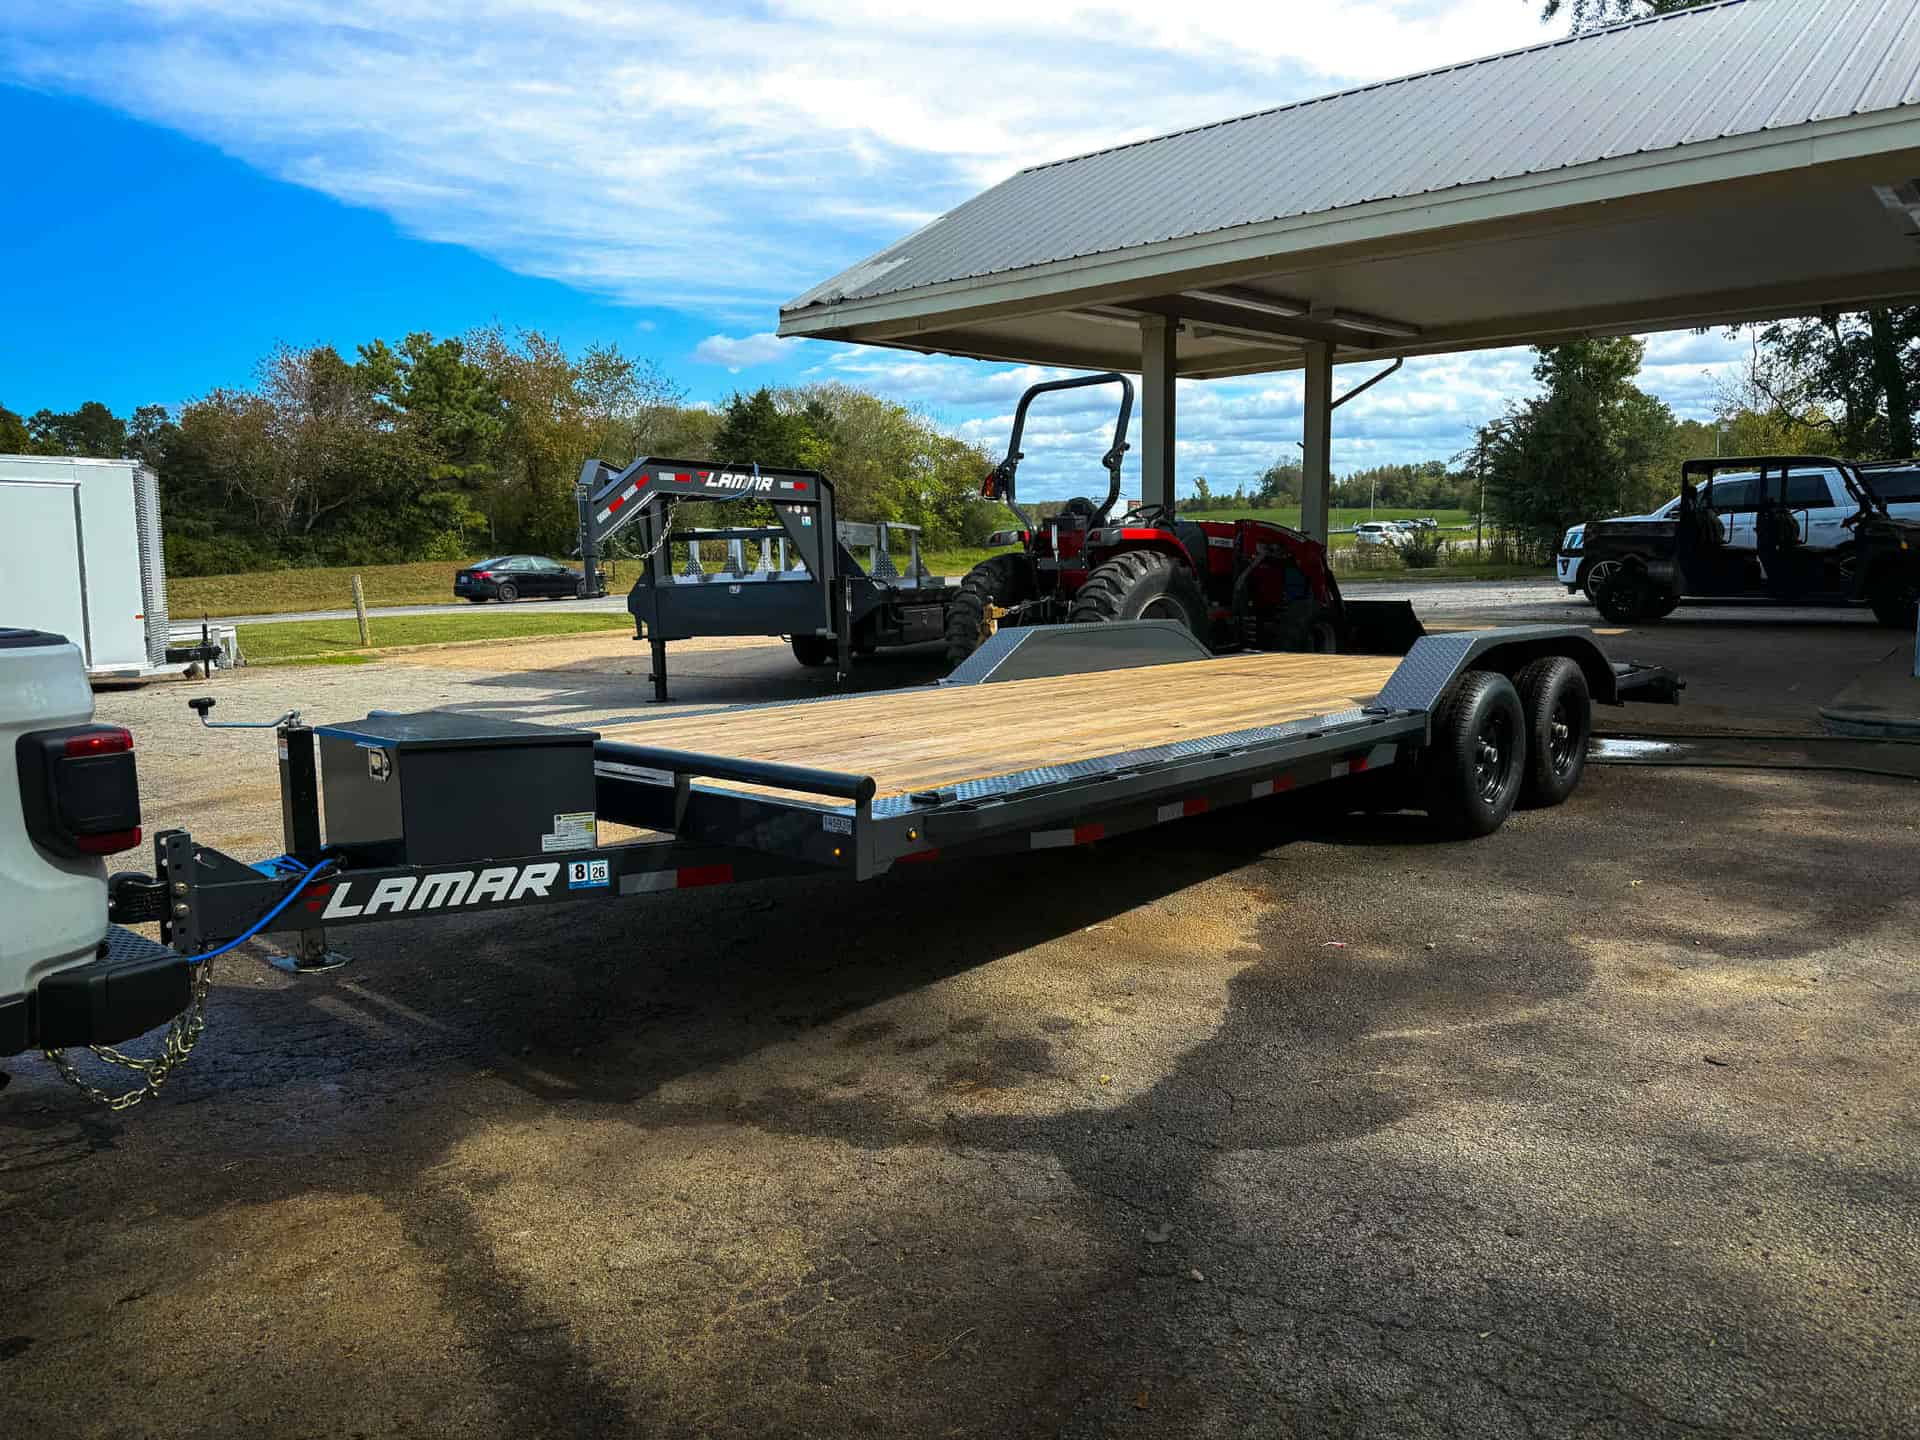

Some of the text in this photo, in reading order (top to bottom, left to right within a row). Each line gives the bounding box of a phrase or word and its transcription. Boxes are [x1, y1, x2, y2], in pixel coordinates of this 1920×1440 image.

[705, 472, 774, 491] LAMAR
[575, 864, 605, 880] 8 26
[321, 862, 560, 919] LAMAR
